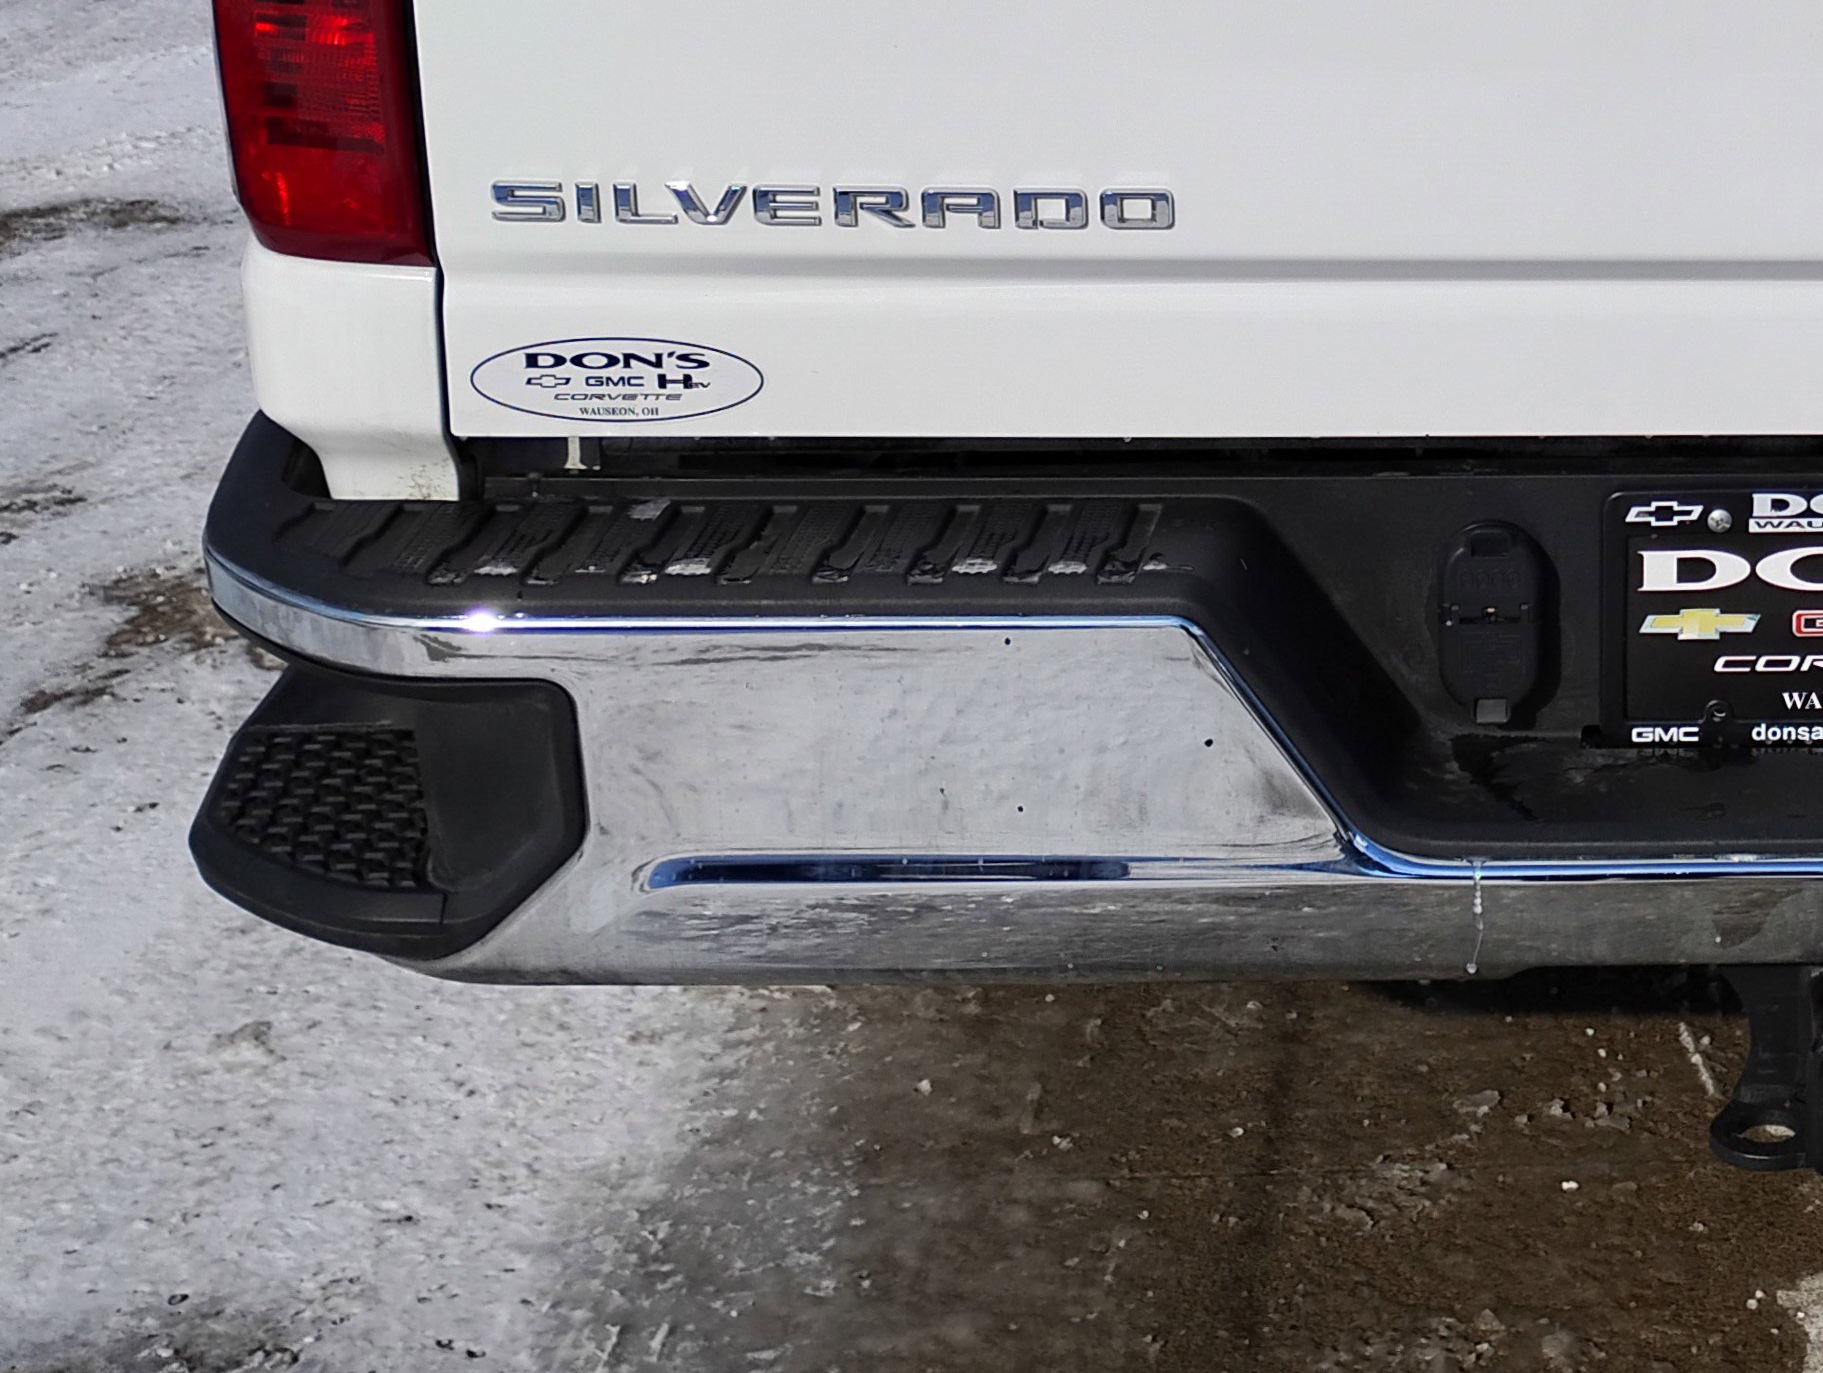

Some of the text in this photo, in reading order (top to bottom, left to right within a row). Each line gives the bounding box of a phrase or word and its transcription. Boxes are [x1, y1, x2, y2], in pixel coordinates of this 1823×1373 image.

[490, 179, 1176, 231] SILVERADO
[524, 351, 710, 370] DON'S
[584, 375, 645, 387] GMC
[553, 393, 683, 401] CORVETTE
[578, 406, 660, 417] WAUSEON, OH
[1631, 726, 1700, 743] GMC
